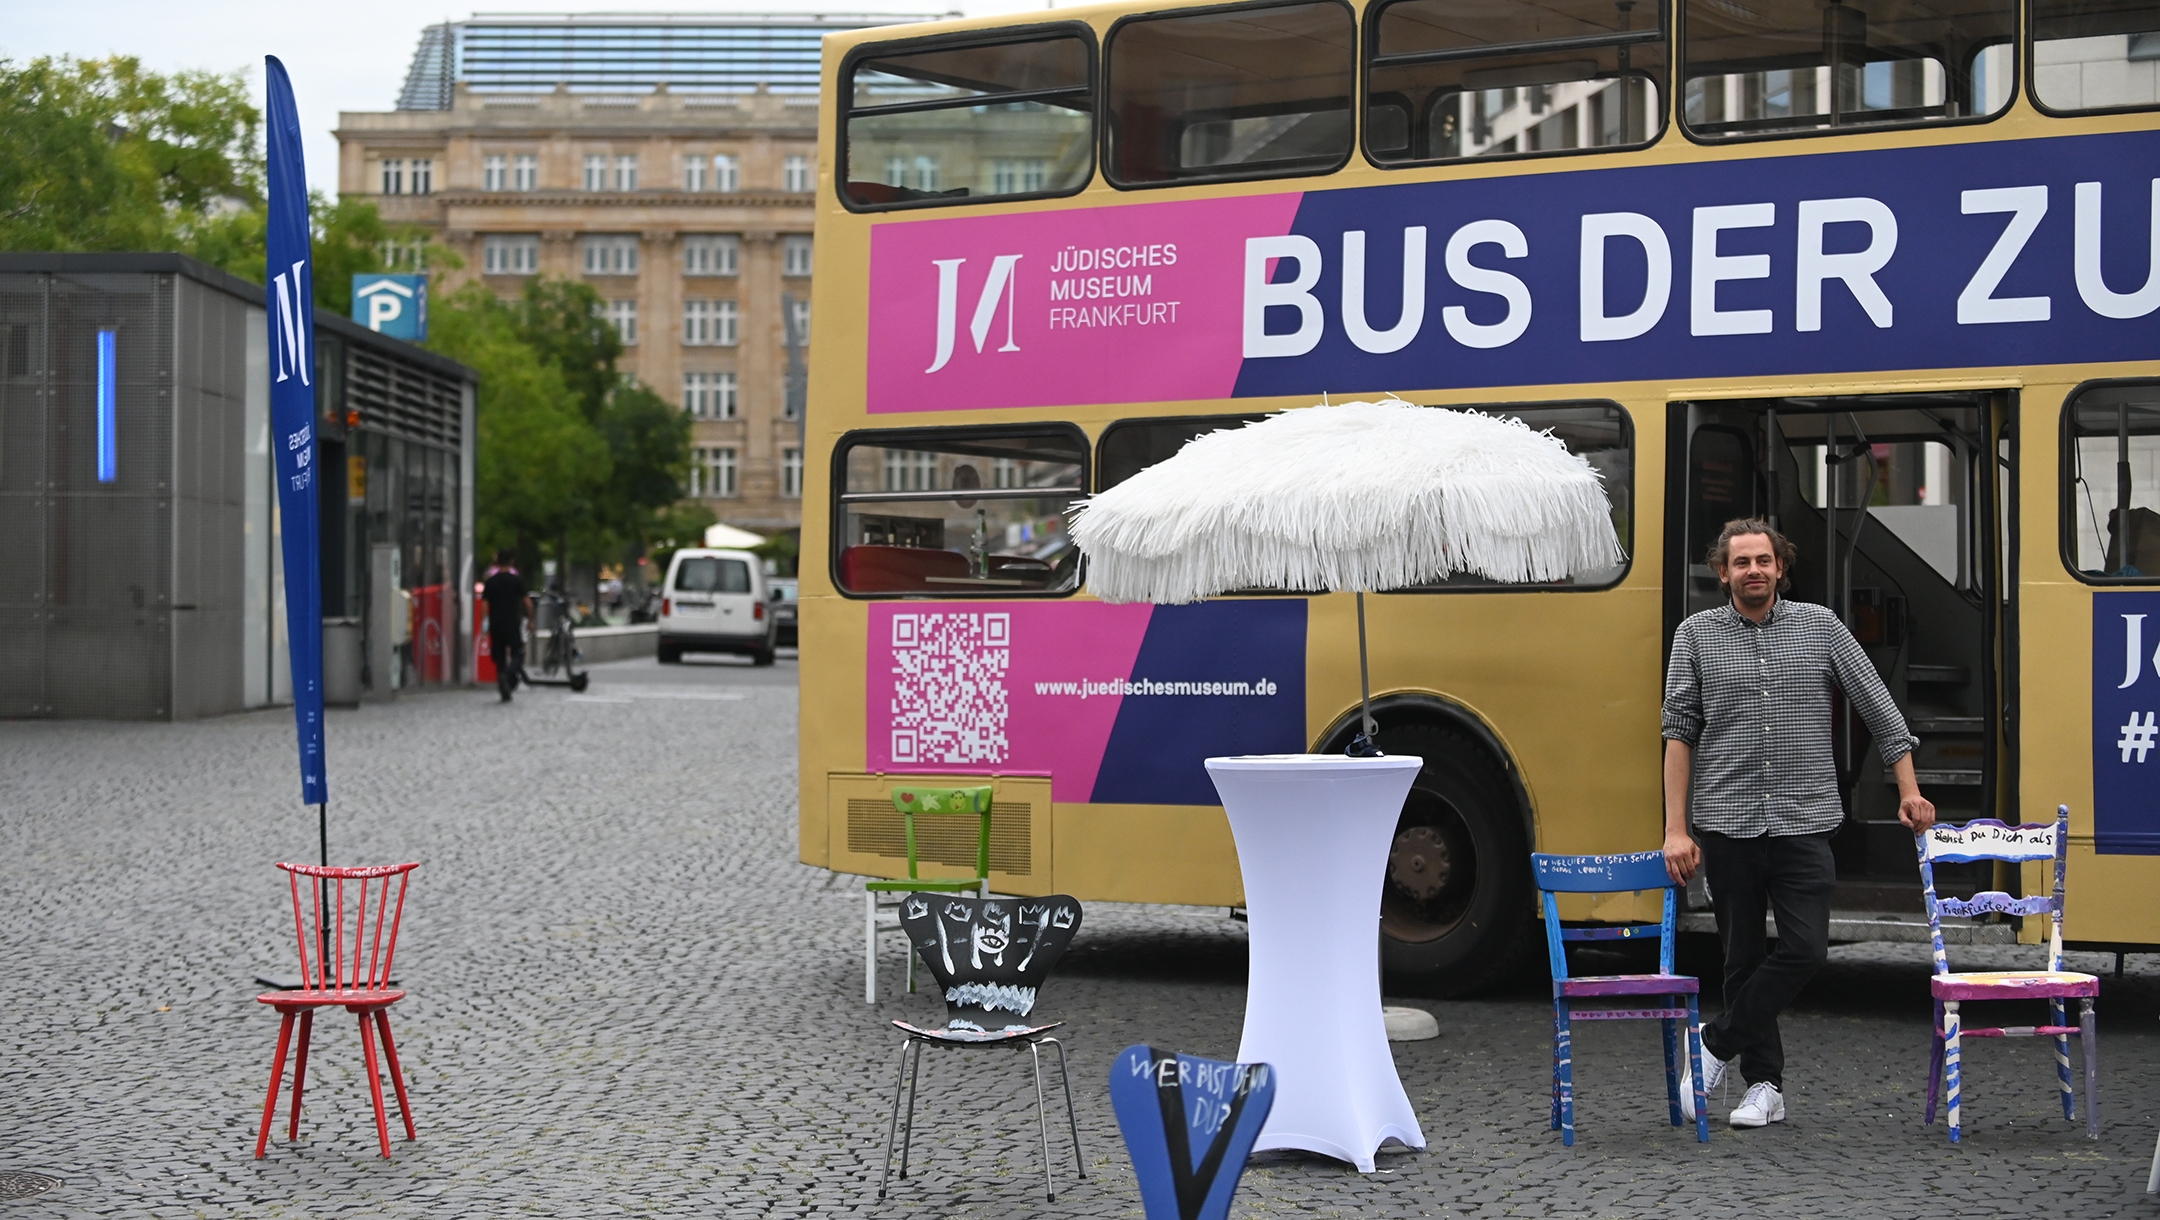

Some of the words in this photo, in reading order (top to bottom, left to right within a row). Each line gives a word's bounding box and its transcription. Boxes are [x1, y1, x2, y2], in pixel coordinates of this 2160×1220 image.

[1050, 243, 1178, 274] JÜDISCHES
[1242, 218, 1533, 359] BUS
[1579, 196, 1899, 343] DER
[1957, 177, 2160, 326] ZU
[1050, 274, 1153, 301] MUSEUM
[369, 294, 402, 333] P
[1049, 301, 1181, 330] FRANKFURT
[1034, 677, 1278, 700] www.juedischesmuseum.de
[1992, 828, 2023, 844] Dich
[2029, 831, 2053, 845] als
[1130, 1053, 1192, 1088] WER
[1196, 1062, 1233, 1100] BIST
[1232, 1064, 1269, 1097] DENN
[1192, 1096, 1232, 1135] DU?
